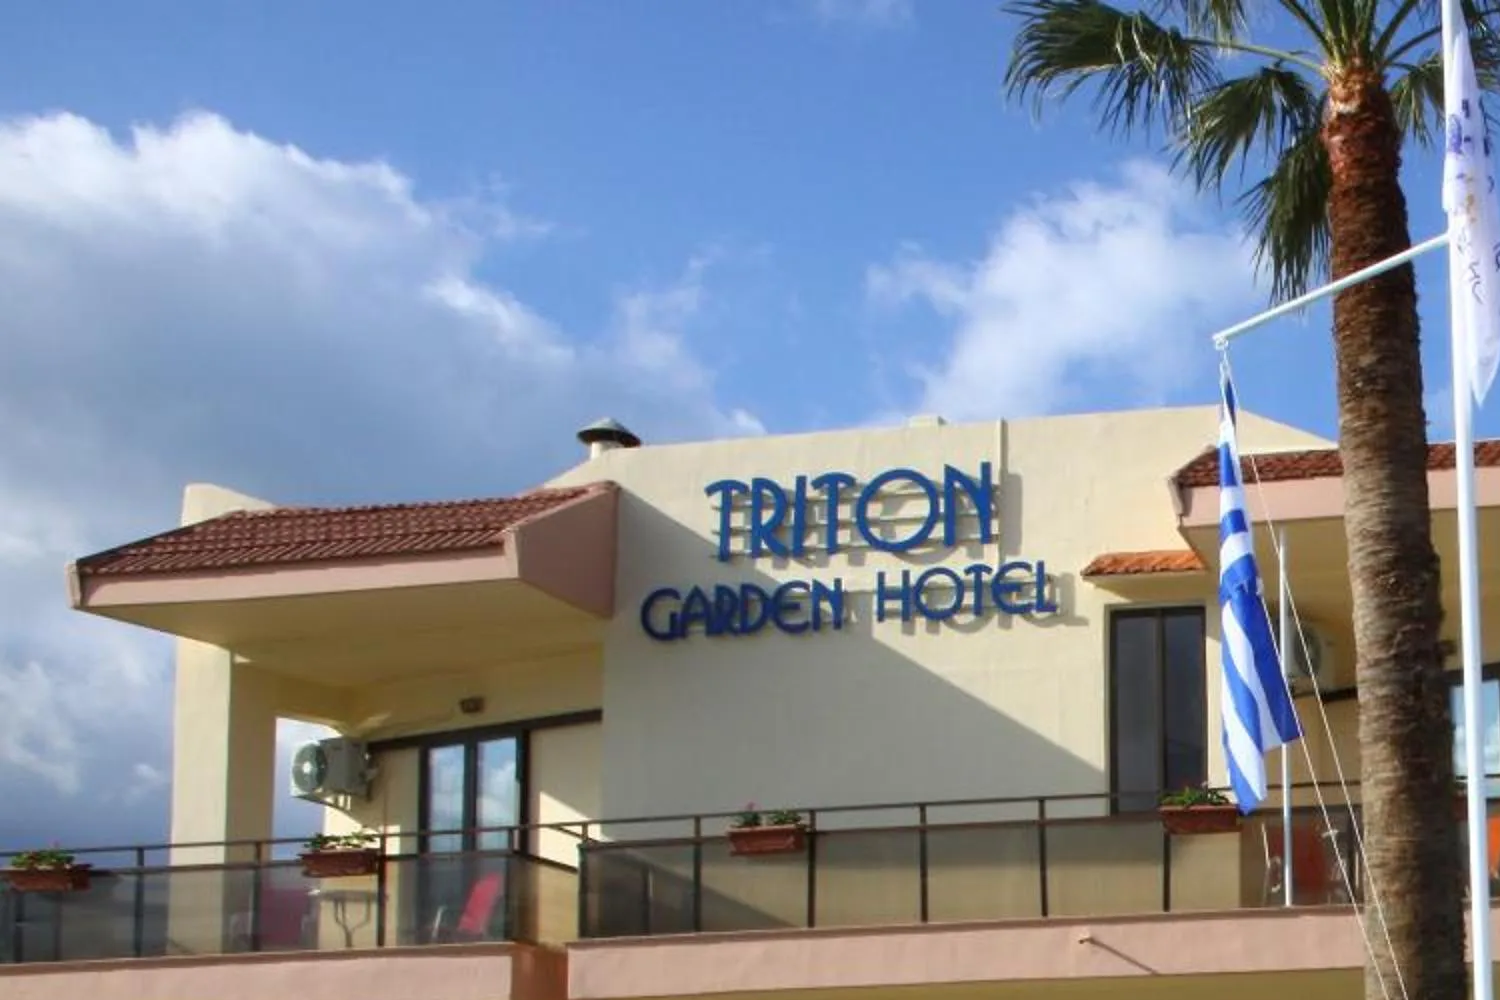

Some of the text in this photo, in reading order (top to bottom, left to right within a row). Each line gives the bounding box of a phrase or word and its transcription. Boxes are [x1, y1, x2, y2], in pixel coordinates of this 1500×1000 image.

[705, 461, 992, 563] TRITON
[641, 561, 1058, 642] GARDEN HOTEL
